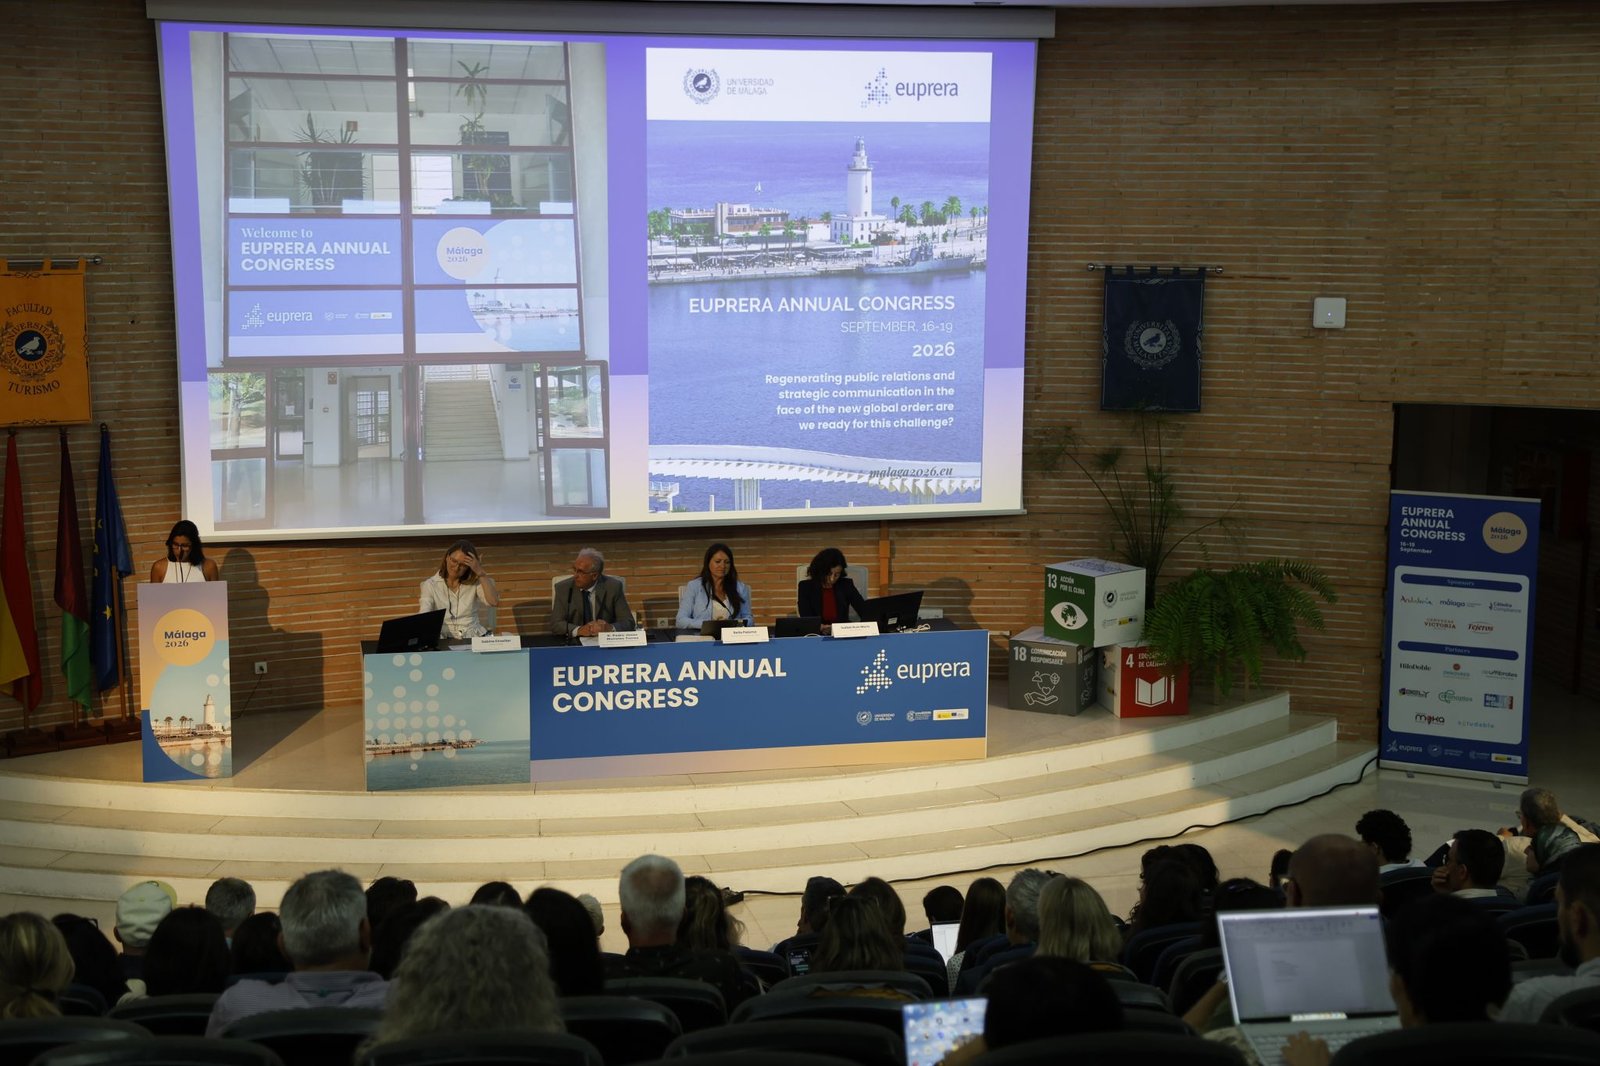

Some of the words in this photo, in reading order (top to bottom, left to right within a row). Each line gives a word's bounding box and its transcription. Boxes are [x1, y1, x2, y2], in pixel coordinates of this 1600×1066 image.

[895, 82, 959, 102] euprera
[241, 227, 298, 238] Welcome
[301, 228, 313, 238] to
[241, 242, 317, 255] EUPRERA
[321, 241, 391, 255] ANNUAL
[446, 246, 484, 257] Málaga
[241, 258, 335, 272] CONGRESS
[6, 303, 53, 317] FACULTAD
[688, 297, 774, 313] EUPRERA
[777, 296, 855, 312] ANNUAL
[858, 295, 955, 311] CONGRESS
[266, 311, 313, 324] euprera
[921, 321, 953, 333] 16-19
[912, 342, 955, 357] 2026
[765, 373, 842, 385] Regenerating
[844, 373, 880, 385] public
[882, 371, 931, 381] relations
[933, 371, 955, 381] and
[7, 380, 61, 396] TURISMO
[778, 388, 830, 401] strategic
[832, 387, 922, 398] communication
[923, 386, 934, 397] in
[936, 386, 955, 397] the
[776, 403, 802, 415] face
[803, 403, 816, 414] of
[816, 404, 836, 414] the
[838, 404, 861, 413] new
[863, 402, 899, 416] global
[935, 403, 954, 412] are
[799, 421, 814, 431] we
[817, 420, 850, 432] ready
[852, 419, 868, 430] for
[870, 418, 892, 429] this
[893, 417, 954, 430] challenge?
[869, 466, 953, 479] malaga2026.eu
[1401, 506, 1455, 518] EUPRERA
[1401, 518, 1451, 529] ANNUAL
[1401, 528, 1466, 541] CONGRESS
[1047, 573, 1058, 589] 13
[1424, 621, 1456, 629] VICTORIA
[164, 630, 206, 641] Málaga
[164, 640, 189, 648] 2026
[1013, 646, 1027, 661] 18
[1126, 653, 1135, 668] 4
[552, 661, 672, 687] EUPRERA
[677, 657, 787, 682] ANNUAL
[897, 661, 971, 684] euprera
[552, 686, 699, 713] CONGRESS
